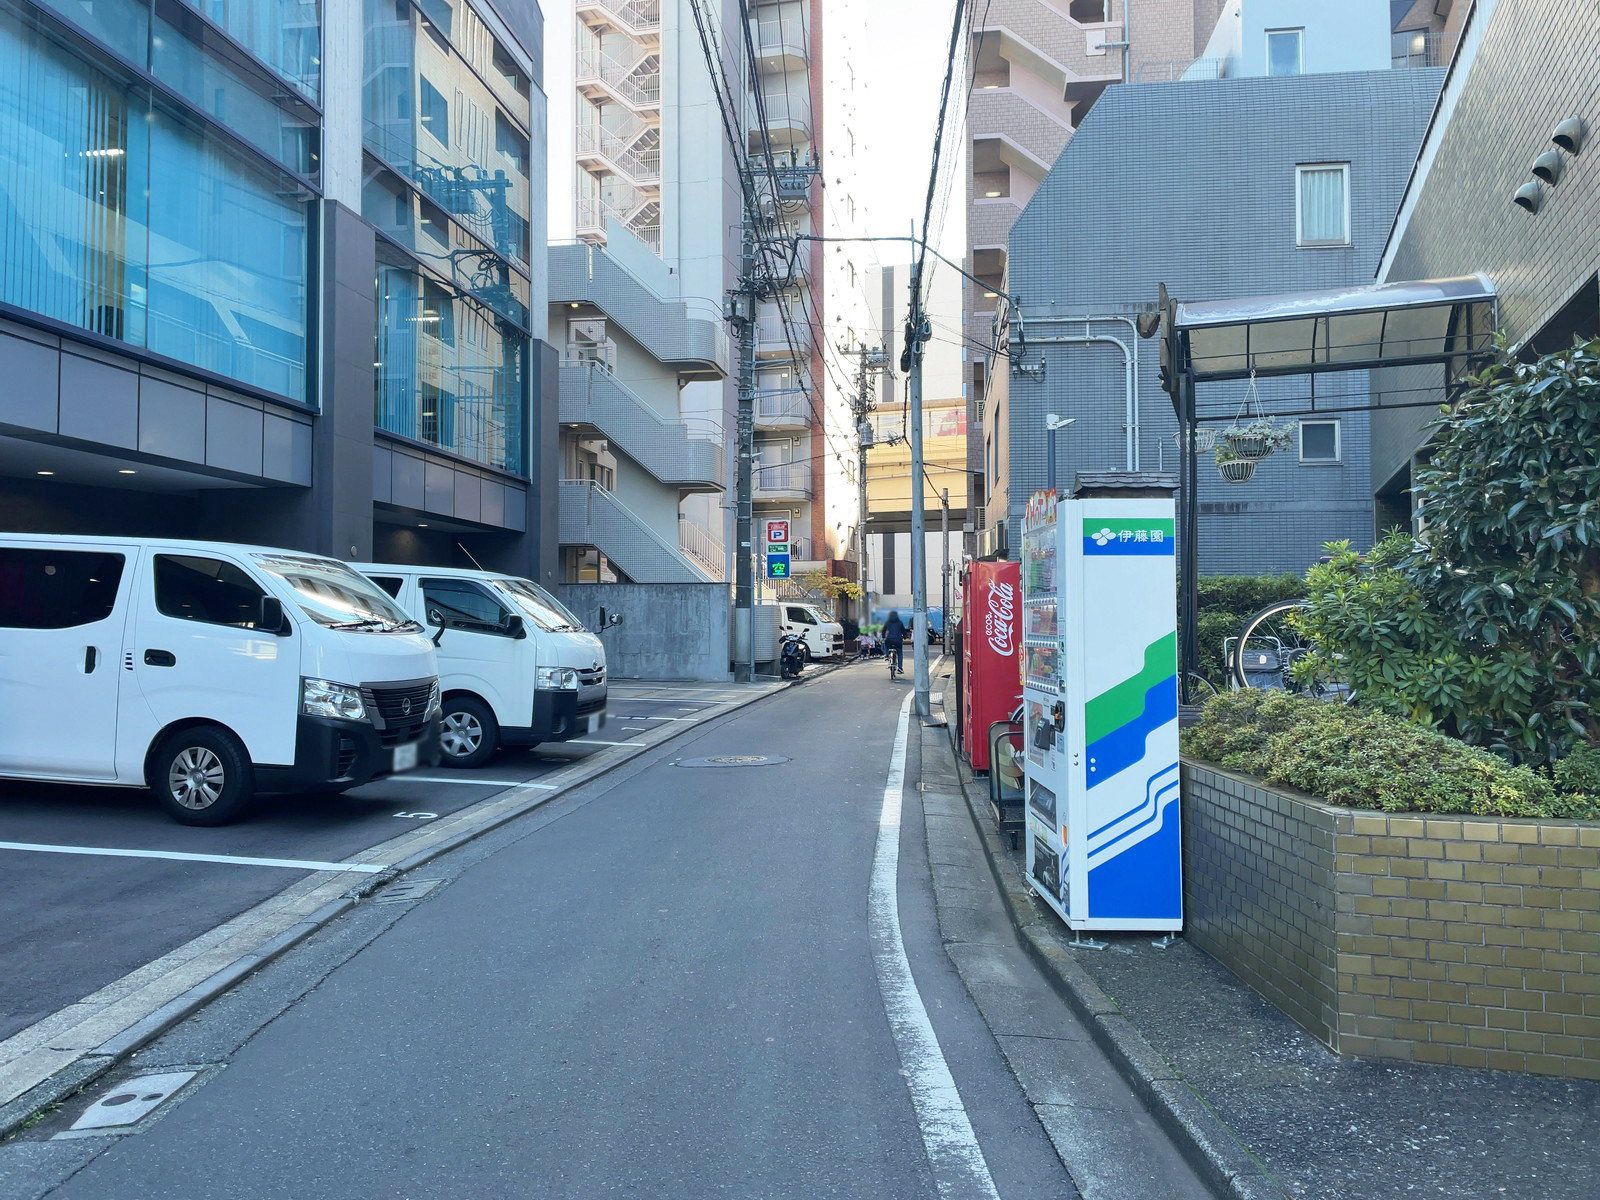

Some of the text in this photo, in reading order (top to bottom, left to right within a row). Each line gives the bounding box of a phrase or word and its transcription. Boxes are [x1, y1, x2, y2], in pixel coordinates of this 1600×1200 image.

[773, 531, 782, 539] P
[1118, 529, 1164, 543] 伊藤園
[772, 562, 785, 576] 空
[988, 579, 1014, 656] Coca-Cola
[392, 811, 439, 819] 5
